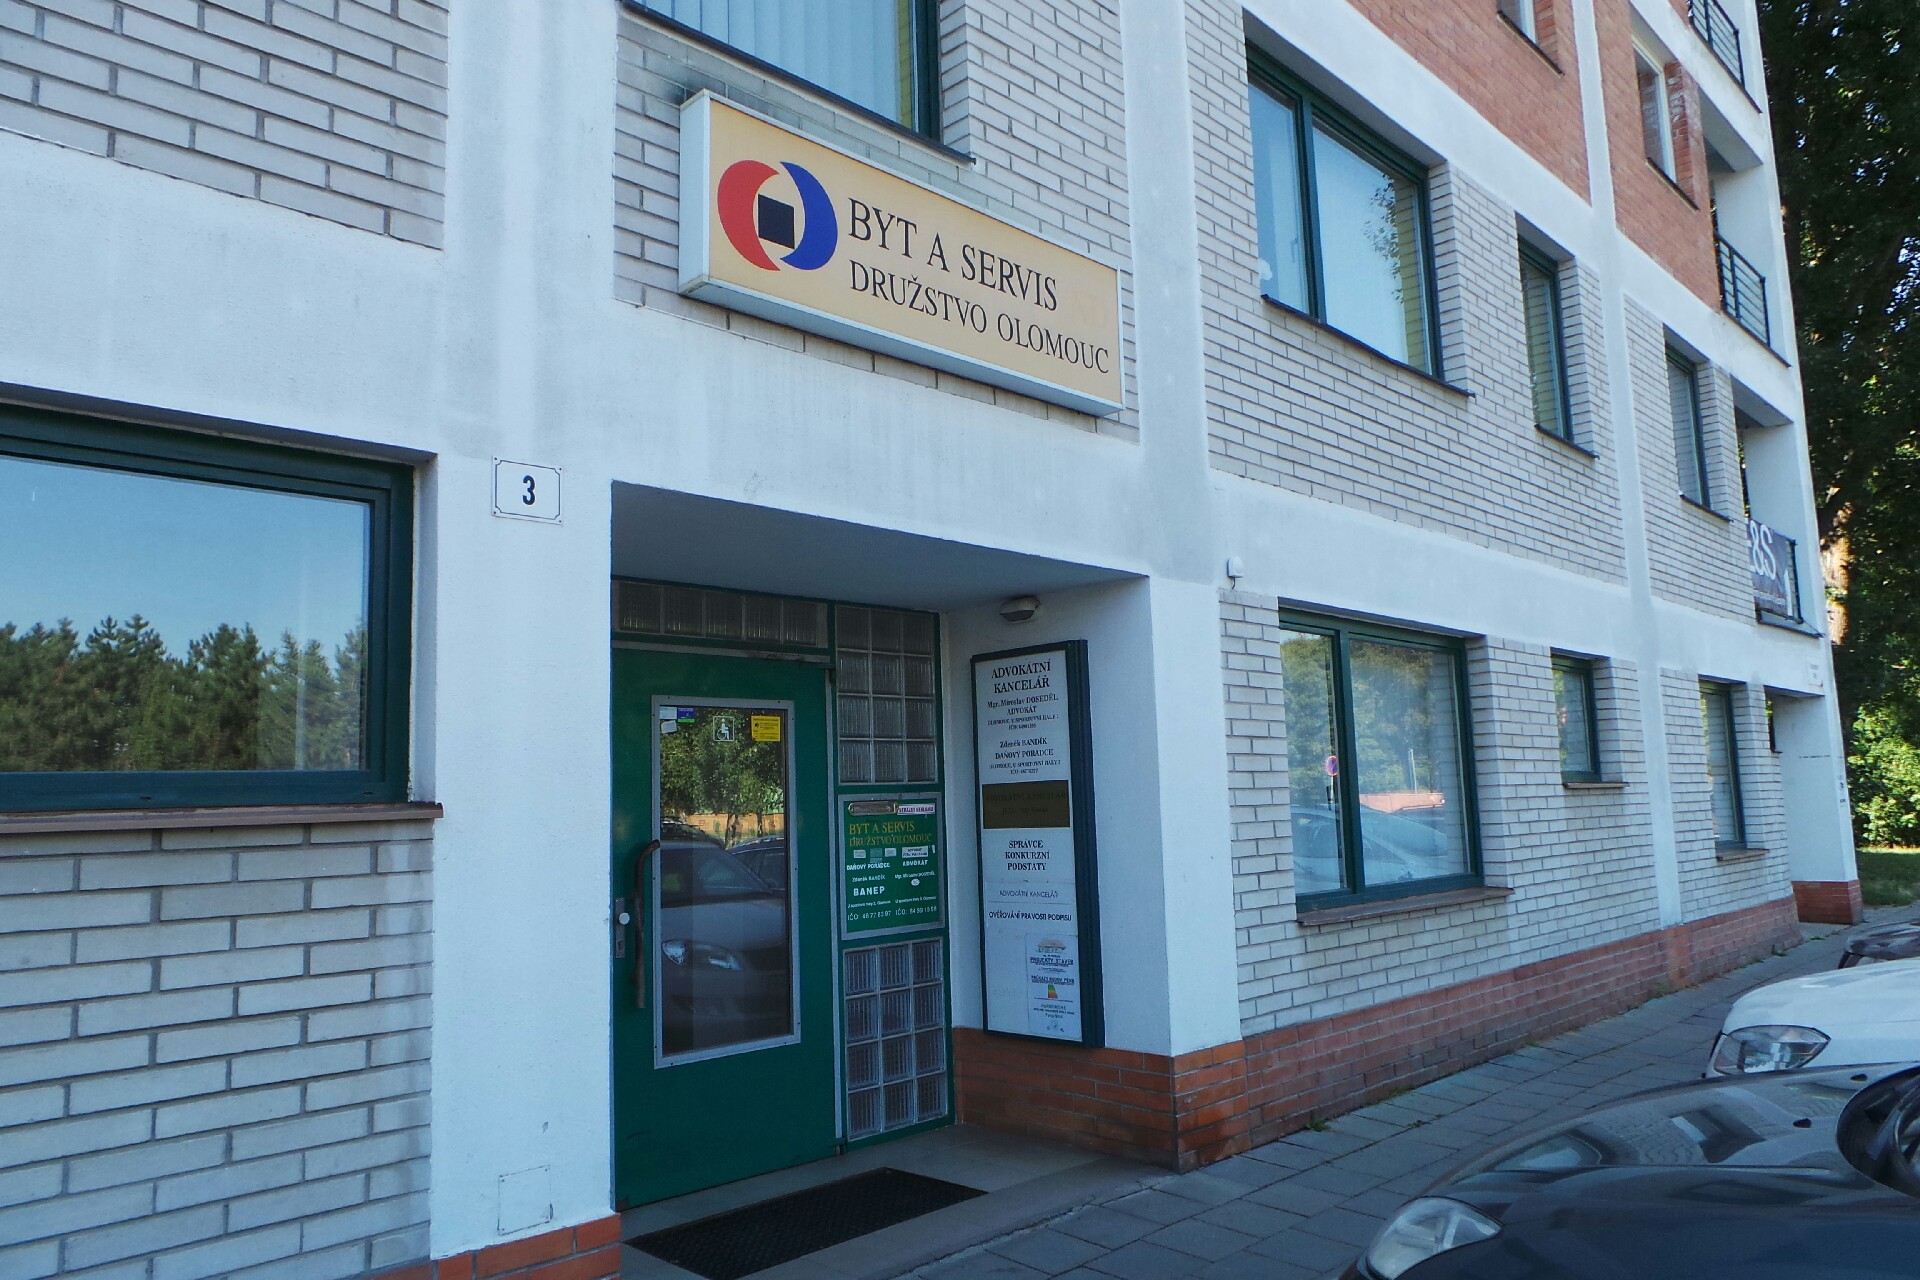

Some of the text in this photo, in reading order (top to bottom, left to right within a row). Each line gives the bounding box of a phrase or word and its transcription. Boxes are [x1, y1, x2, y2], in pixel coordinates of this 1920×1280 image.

[848, 197, 1058, 312] BYT A SERVIS
[849, 259, 1109, 374] DRUŽSTVO OLOMOUC
[522, 474, 536, 506] 3
[991, 659, 1051, 679] ADVOKÁTNÍ
[993, 675, 1050, 694] KANCELÁŘ
[849, 820, 915, 835] BYT A SERVIS
[849, 833, 932, 847] DRUŽSTVO OLOMOUC
[1008, 839, 1044, 849] SPRÁVCE
[1005, 850, 1050, 860] KONKURZNÍ
[1007, 862, 1047, 871] PODSTATY
[853, 885, 885, 897] BANEP
[1021, 912, 1047, 921] PRAVOSTI
